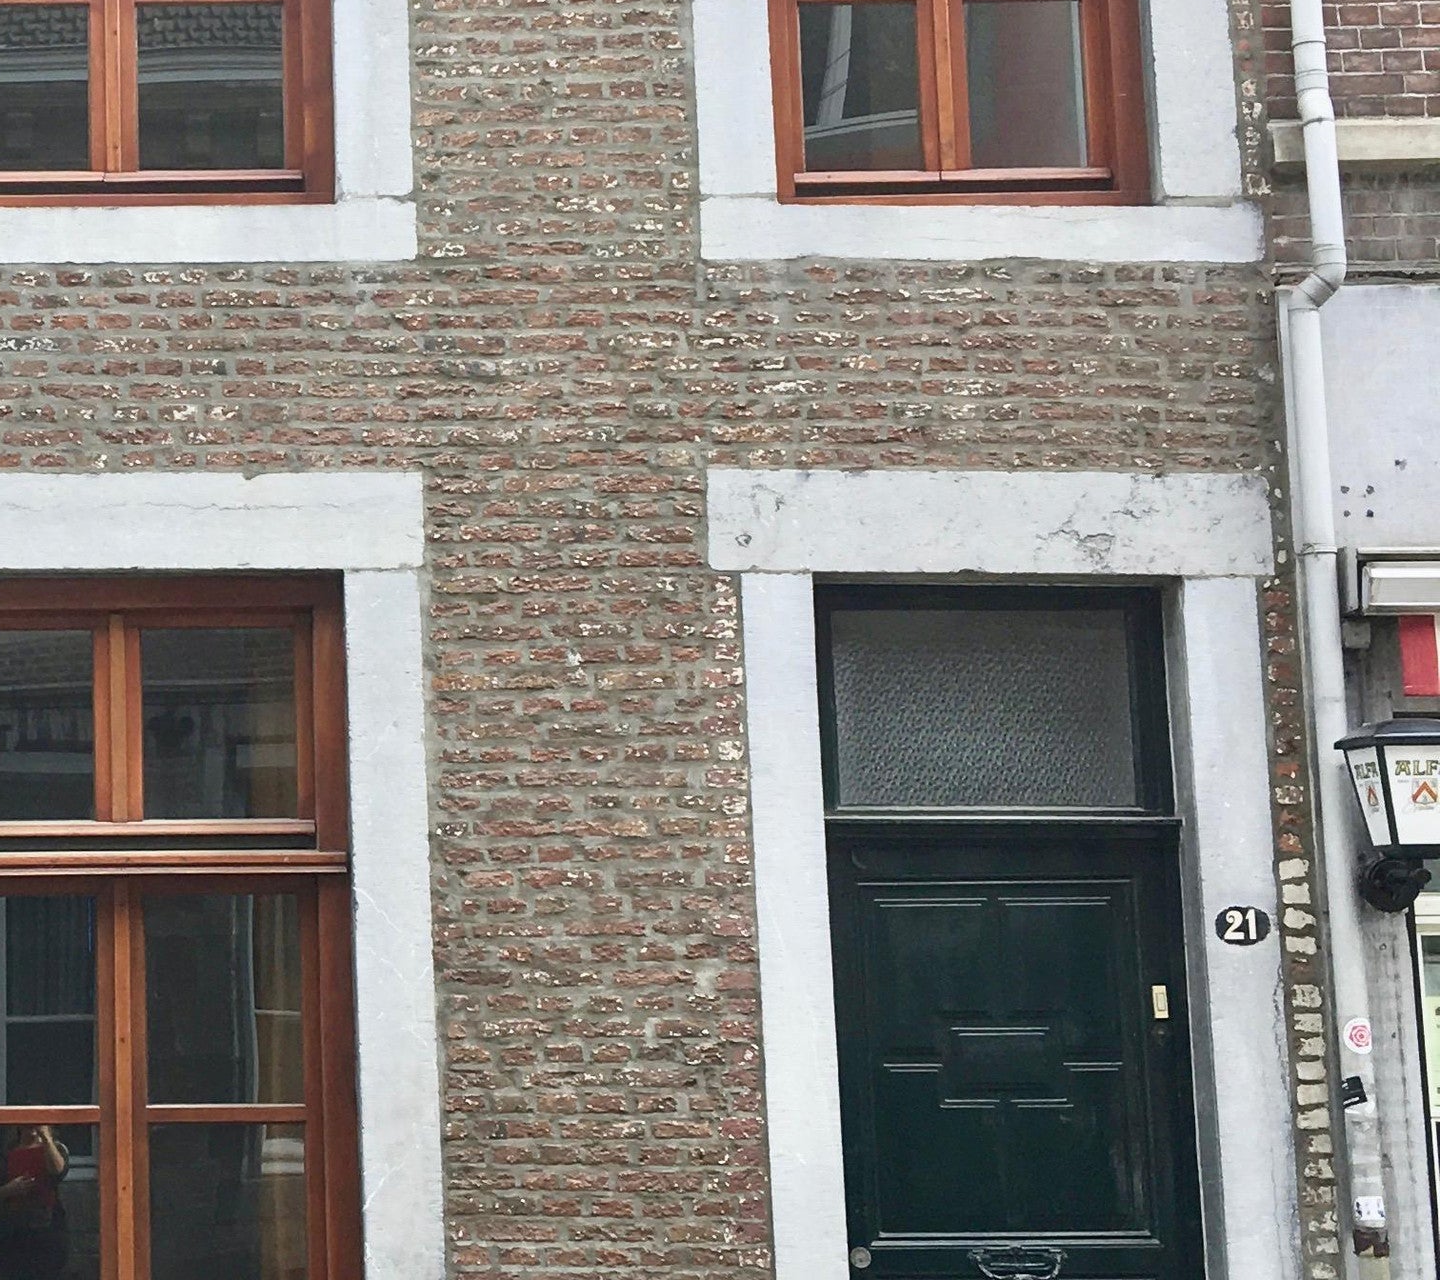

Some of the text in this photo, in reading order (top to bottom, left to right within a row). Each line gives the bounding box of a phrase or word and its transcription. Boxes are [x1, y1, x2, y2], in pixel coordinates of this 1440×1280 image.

[1354, 761, 1379, 780] ALFA
[1394, 760, 1440, 776] ALF
[1224, 909, 1257, 940] 21
